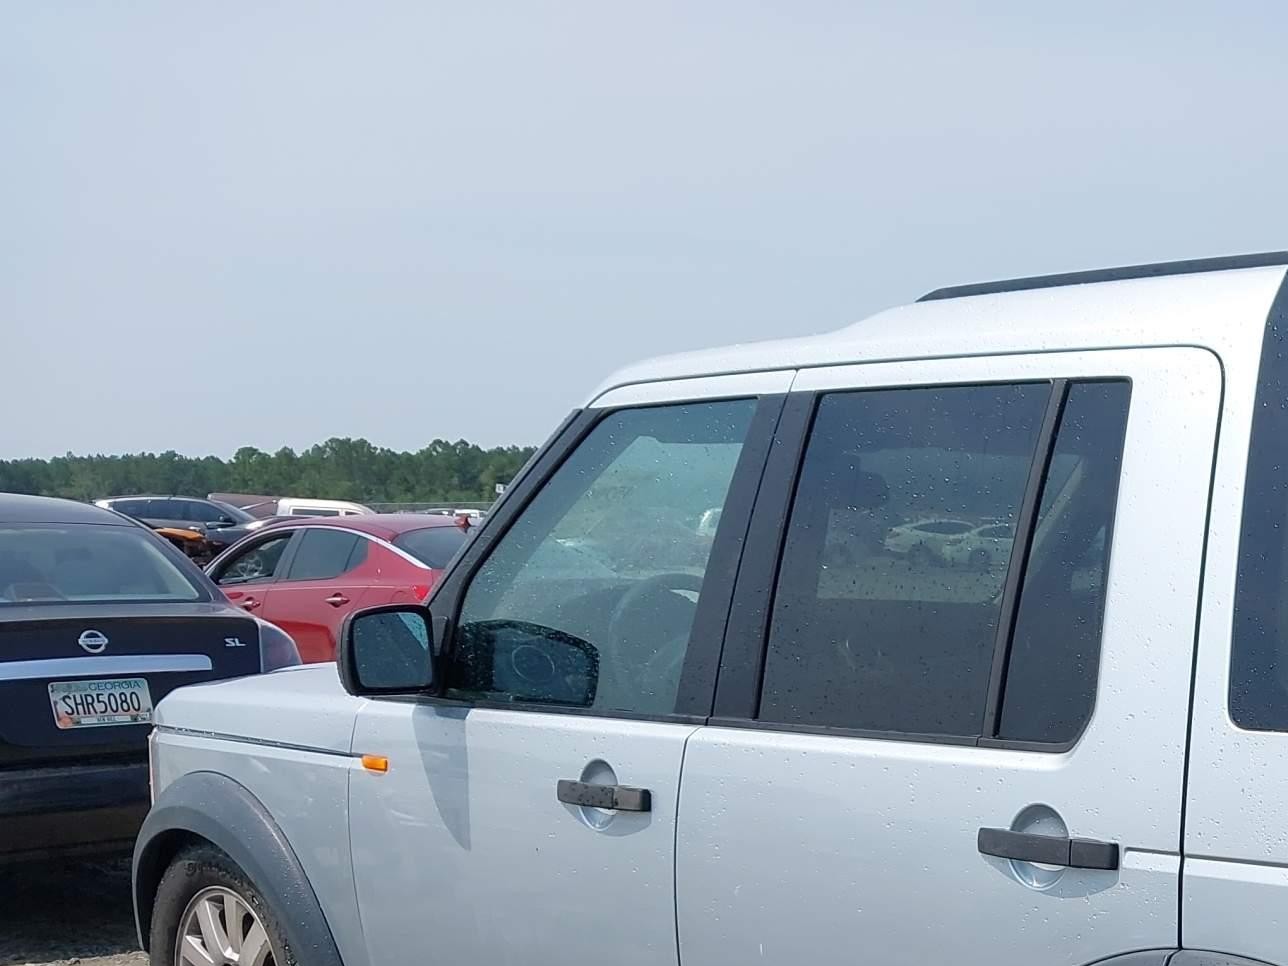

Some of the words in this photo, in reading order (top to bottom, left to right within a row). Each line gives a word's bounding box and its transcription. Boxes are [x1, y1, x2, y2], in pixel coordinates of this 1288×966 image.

[224, 637, 247, 647] SL
[88, 680, 142, 691] GEORGIA
[61, 690, 141, 716] SHR5080
